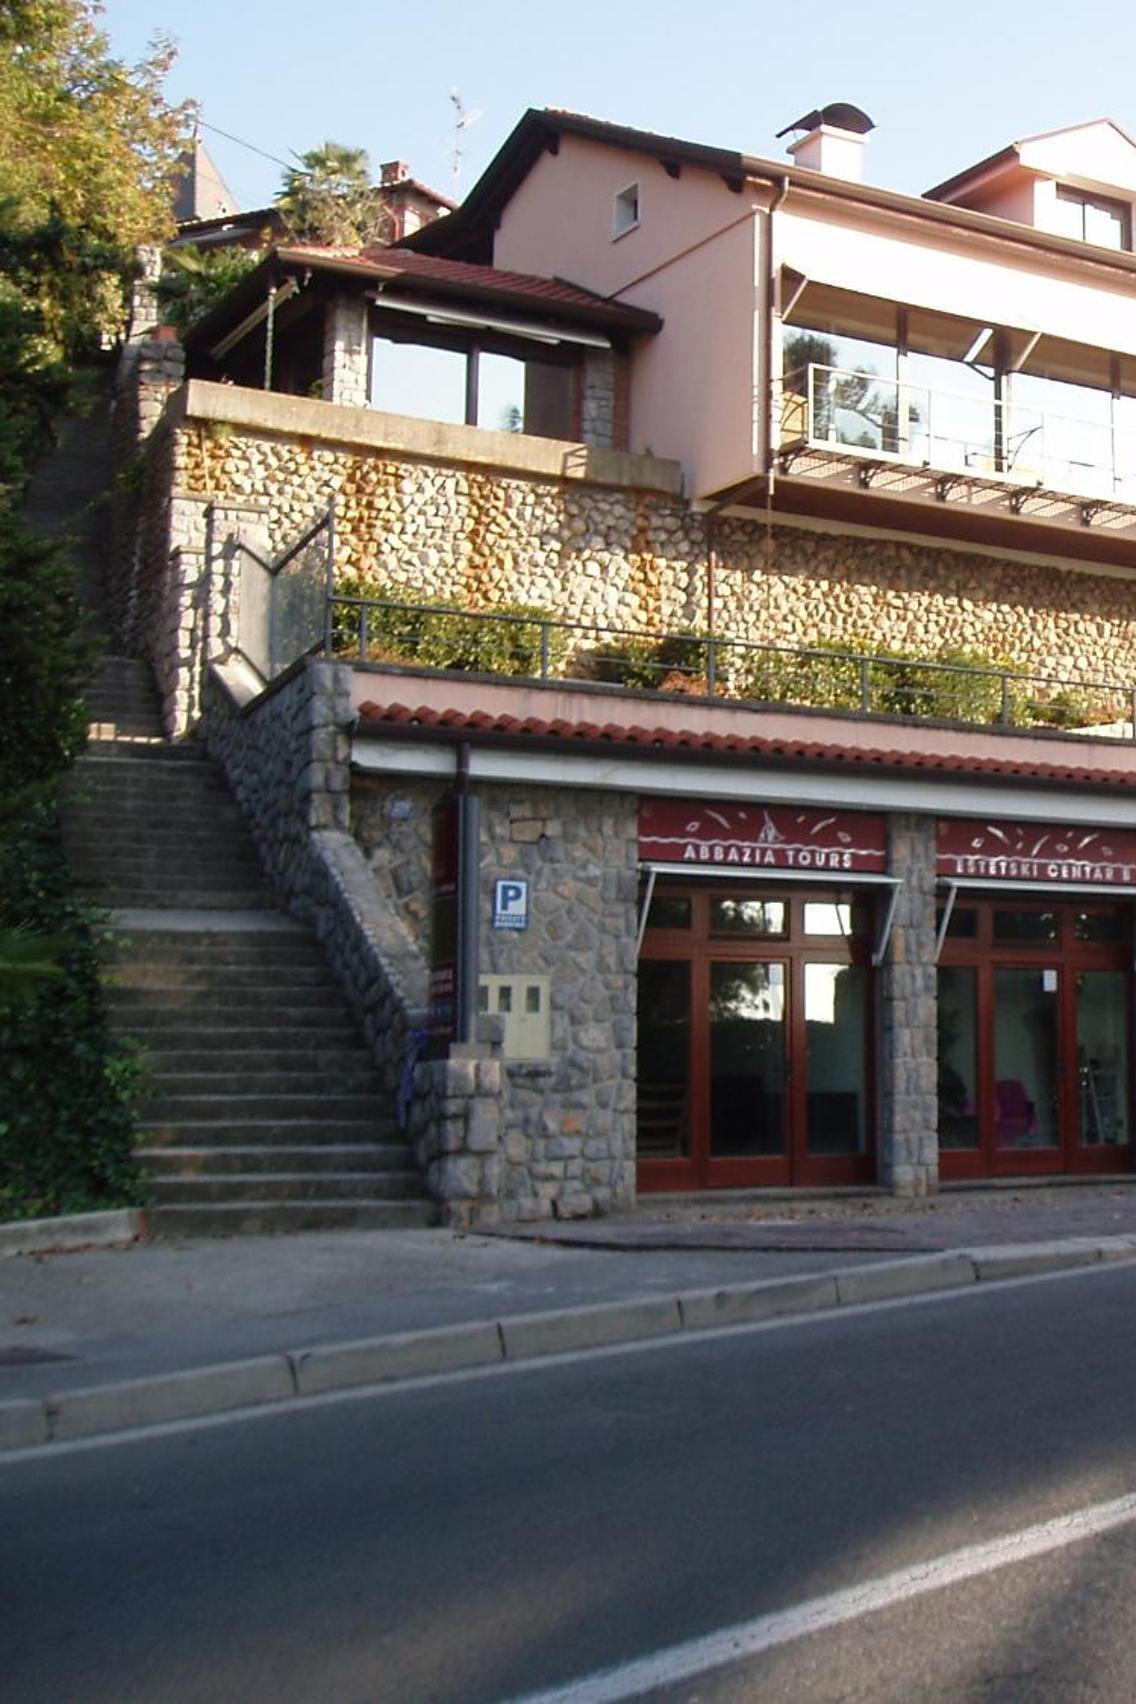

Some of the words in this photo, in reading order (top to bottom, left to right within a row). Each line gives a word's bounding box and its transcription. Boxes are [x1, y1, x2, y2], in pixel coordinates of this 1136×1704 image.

[684, 844, 776, 864] ABBAZIA
[786, 850, 853, 868] TOURS
[955, 859, 1038, 877] ESTETSKI
[1047, 863, 1113, 880] CENTAR
[501, 885, 522, 910] P
